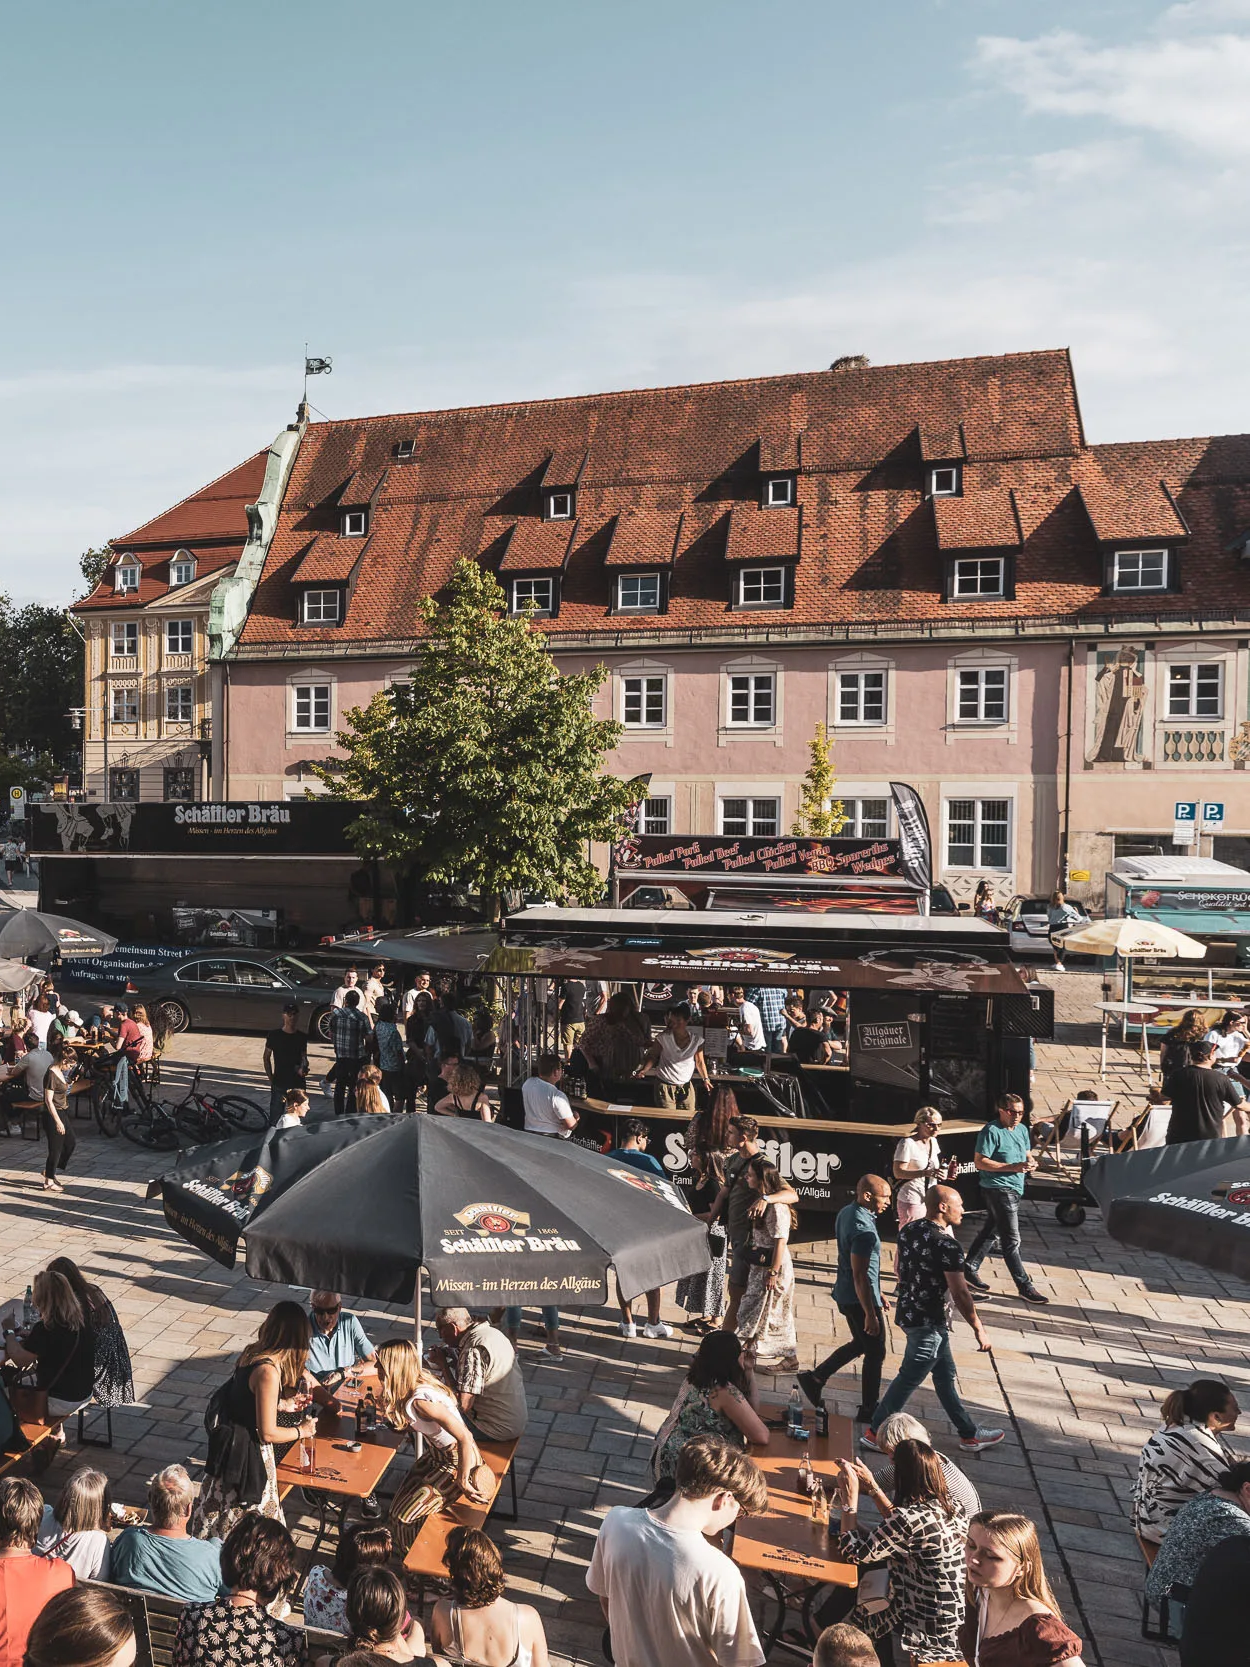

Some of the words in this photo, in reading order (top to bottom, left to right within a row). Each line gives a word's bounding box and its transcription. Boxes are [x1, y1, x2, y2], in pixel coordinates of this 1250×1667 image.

[174, 805, 246, 824] Schäffler
[248, 805, 290, 823] Bräu
[1178, 805, 1190, 818] P
[1206, 805, 1219, 818] P
[643, 850, 675, 868] Pulled
[674, 842, 700, 858] Pork
[682, 850, 715, 870] Pulled
[714, 842, 740, 860] Beef
[721, 851, 755, 871] Pulled
[756, 841, 797, 860] Chicken
[762, 853, 797, 872] Pulled
[798, 845, 831, 861] Vegan
[811, 856, 837, 872] BBQ
[835, 842, 889, 867] Spareribs
[850, 854, 896, 874] Wedges
[115, 946, 156, 955] emeinsam
[158, 948, 182, 958] Street
[92, 958, 144, 969] Organisation
[642, 958, 763, 969] Schäffler
[767, 962, 841, 972] Bräu
[70, 970, 104, 980] Anfragen
[863, 1026, 904, 1038] Allgäuer
[863, 1036, 907, 1048] Originale
[182, 1179, 230, 1206] Schäffler
[463, 1204, 520, 1220] Schäffler
[1149, 1192, 1238, 1220] Schäffler
[440, 1236, 525, 1254] Schäffler
[525, 1236, 582, 1251] Bräu
[435, 1278, 474, 1292] Missen
[482, 1278, 498, 1291] im
[501, 1277, 538, 1291] Herzen
[540, 1276, 558, 1290] des
[560, 1276, 601, 1293] Allgäus
[762, 1553, 800, 1564] Schäffler
[802, 1561, 825, 1569] Bräu
